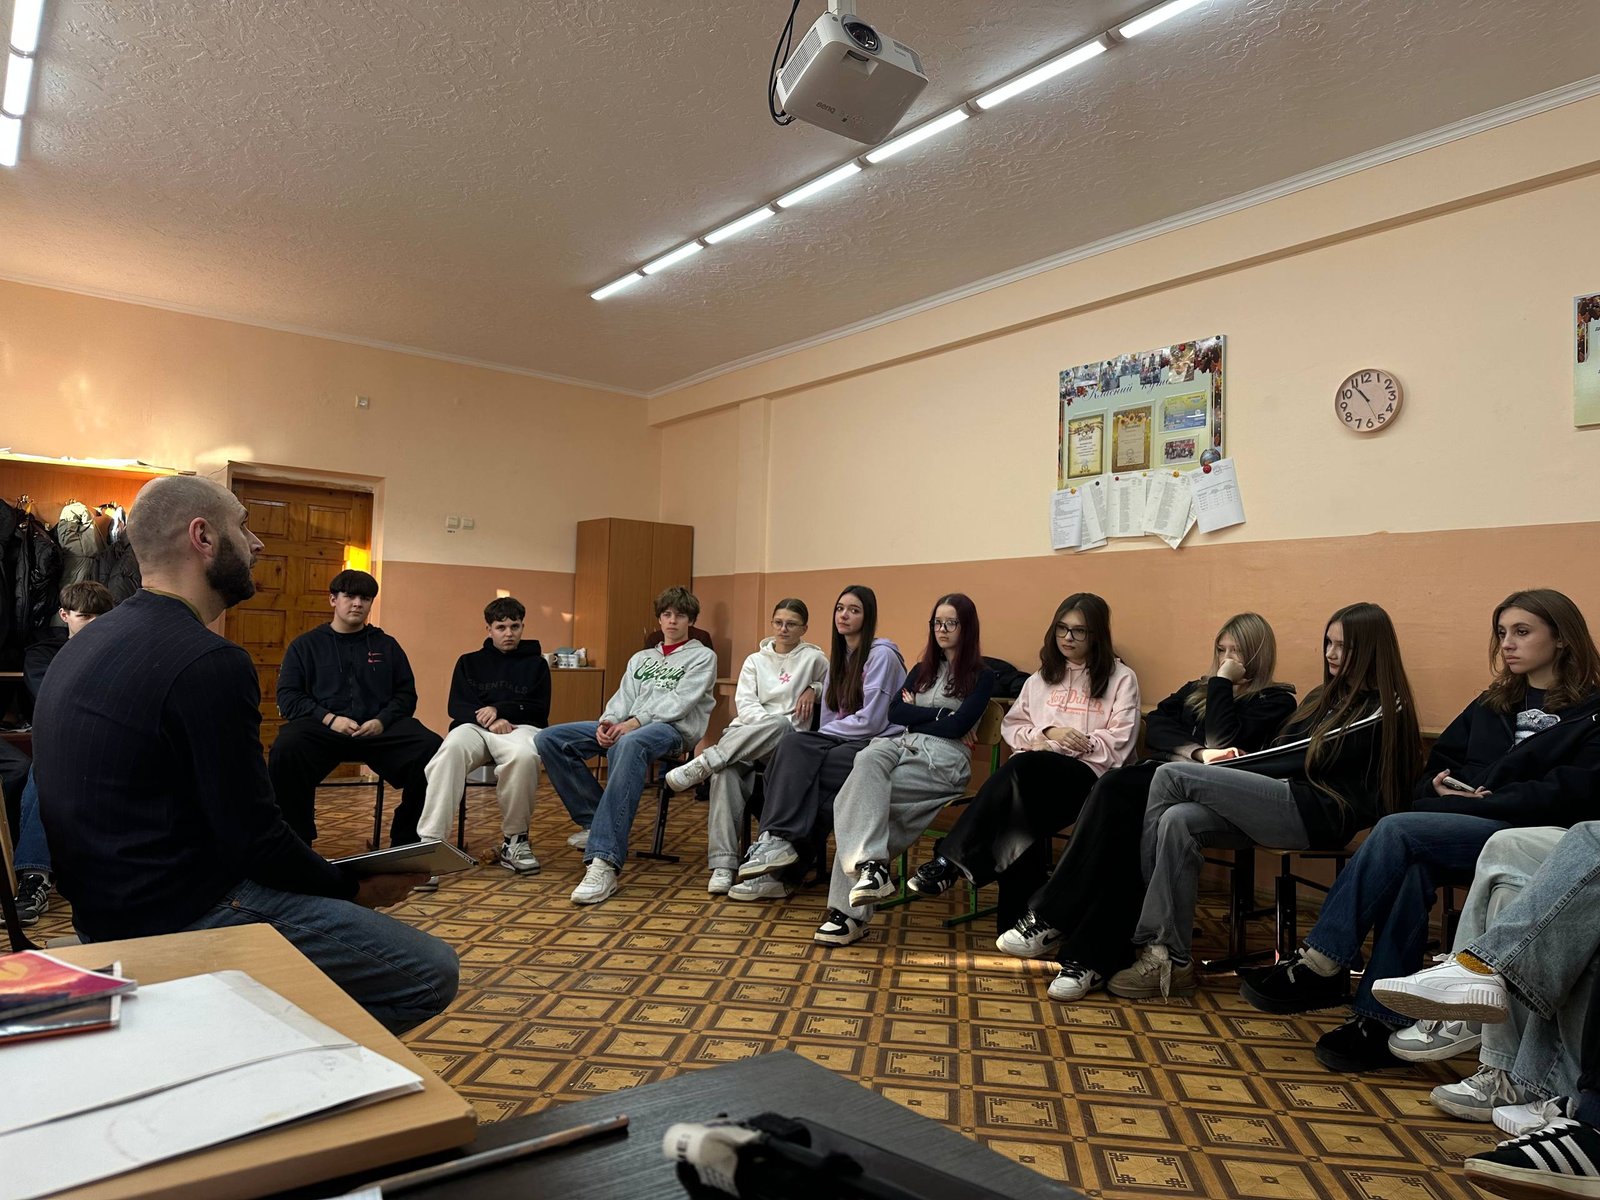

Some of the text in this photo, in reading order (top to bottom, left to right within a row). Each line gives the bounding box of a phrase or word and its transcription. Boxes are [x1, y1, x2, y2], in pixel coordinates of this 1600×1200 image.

[1351, 378, 1358, 389] 11
[1360, 372, 1372, 384] 12
[1376, 373, 1381, 383] 1
[1384, 378, 1393, 390] 2
[1342, 388, 1353, 400] 10
[1388, 390, 1396, 401] 3
[1340, 401, 1348, 412] 9
[1385, 402, 1393, 413] 4
[1345, 412, 1353, 423] 8
[1377, 413, 1386, 424] 5
[1354, 418, 1362, 429] 7
[1366, 418, 1374, 429] 6
